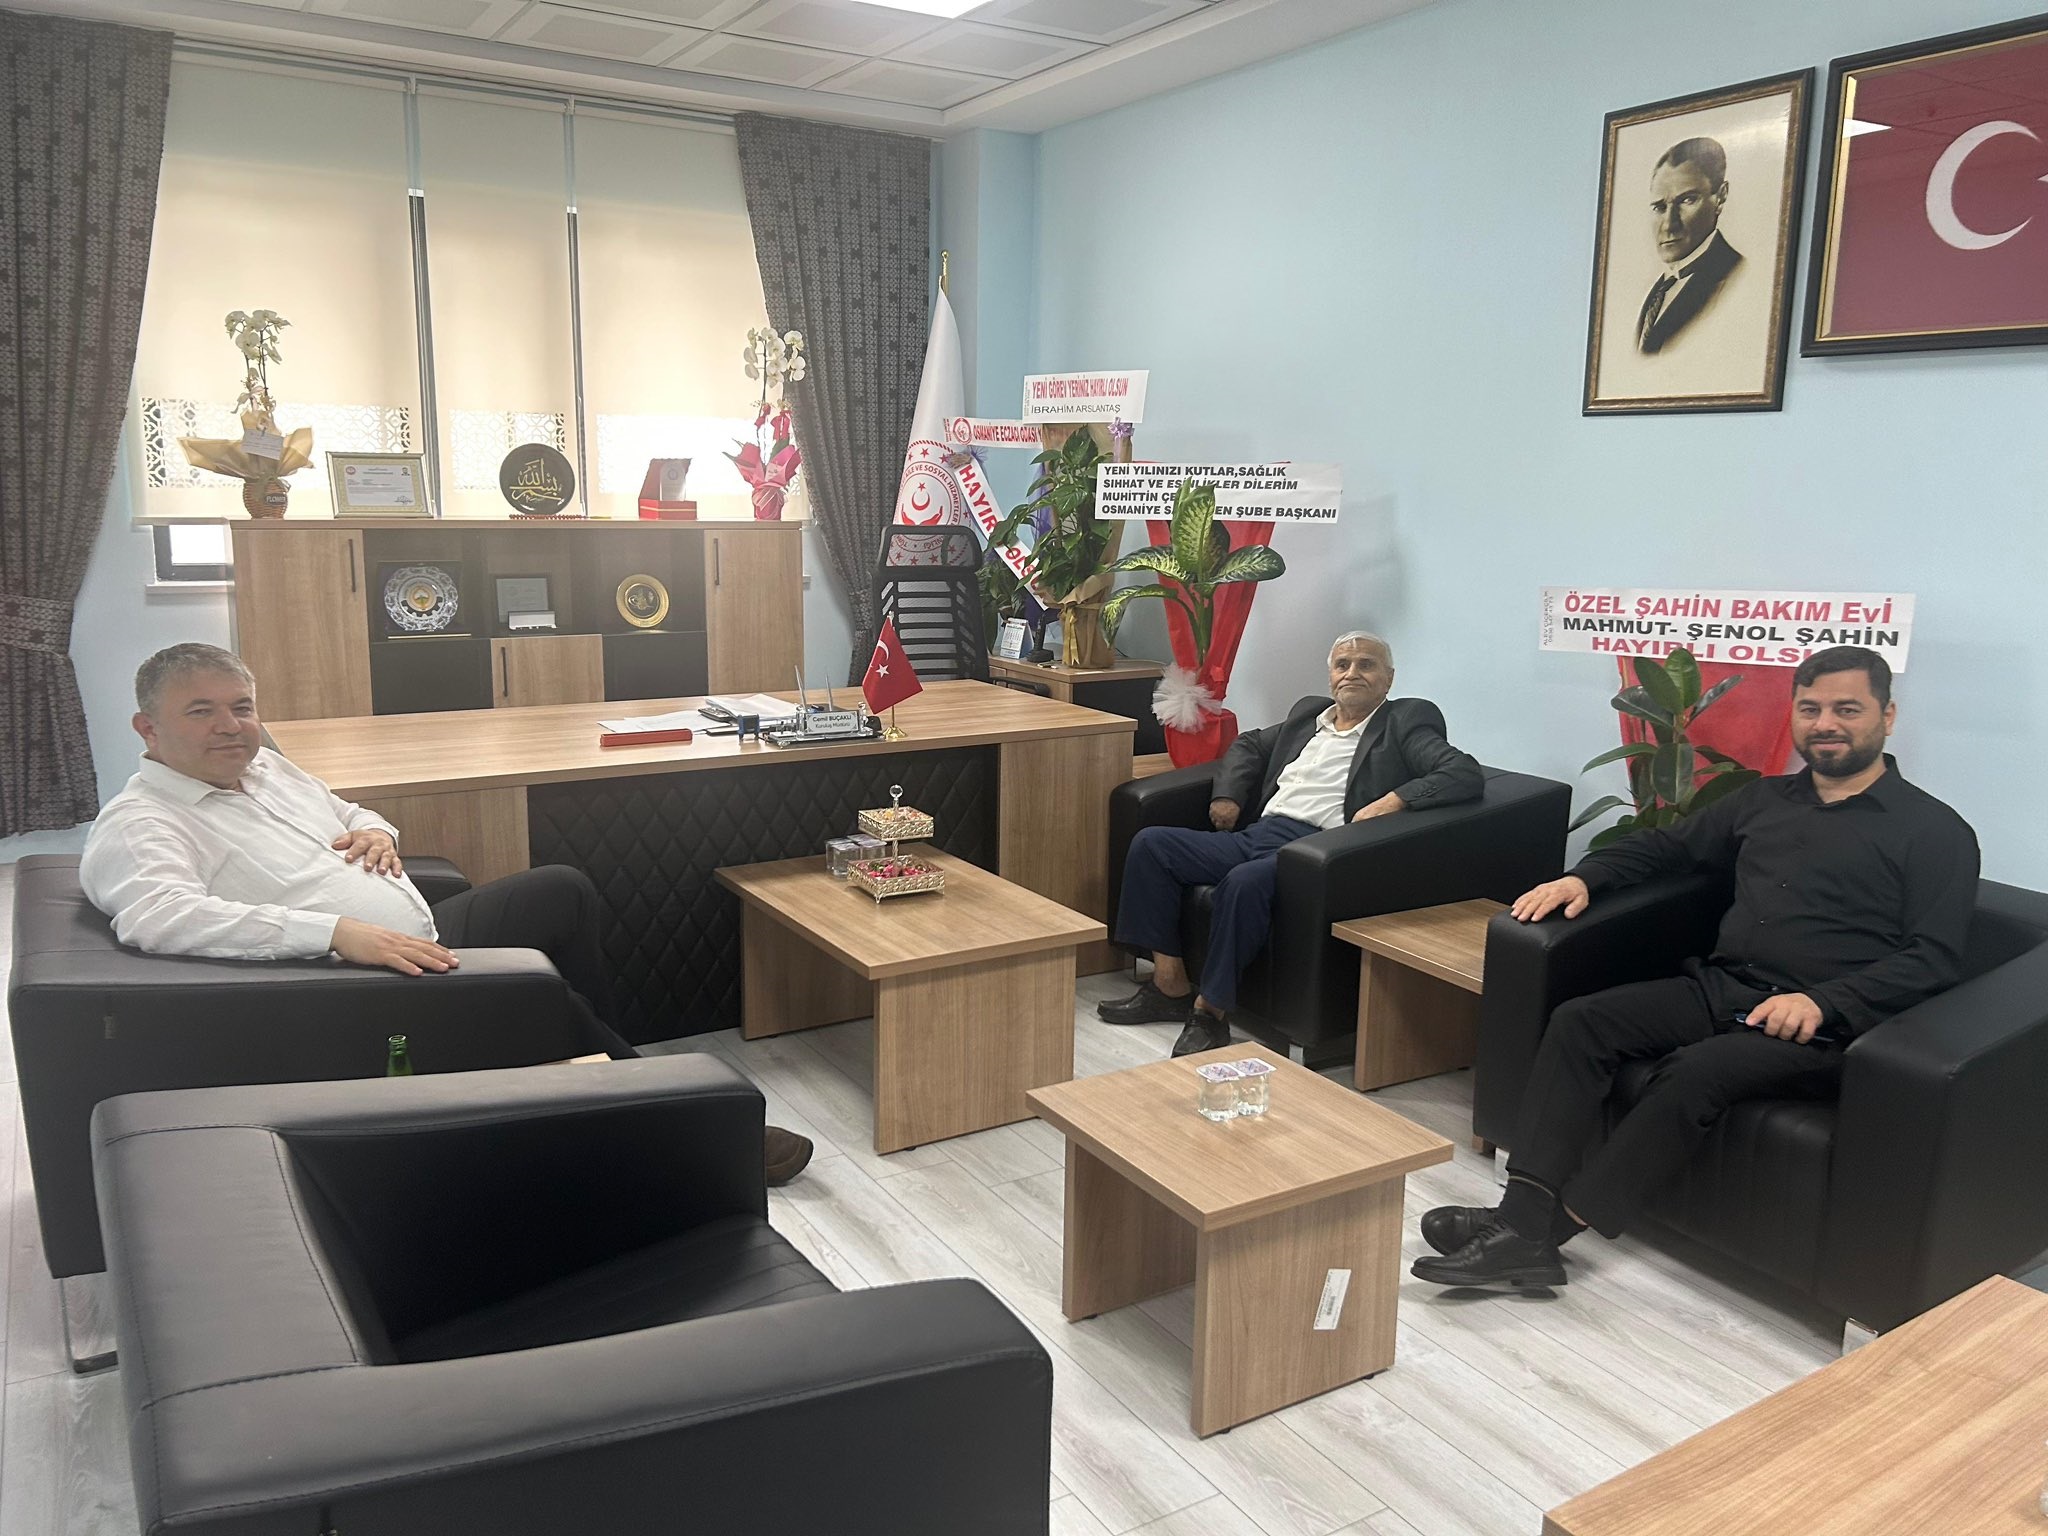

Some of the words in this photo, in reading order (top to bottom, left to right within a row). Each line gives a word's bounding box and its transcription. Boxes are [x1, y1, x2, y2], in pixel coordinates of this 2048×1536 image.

[1032, 377, 1048, 399] YENİ
[1049, 376, 1067, 398] GÖREV
[1068, 375, 1089, 397] YERİNİZ
[1108, 378, 1128, 396] OLSUN
[1031, 405, 1074, 413] İBRAHİM
[1075, 404, 1121, 413] ARSLANTAŞ
[973, 422, 1000, 440] OSMANİYE
[1000, 425, 1020, 442] ECZACI
[1104, 464, 1130, 475] YENİ
[1133, 466, 1181, 475] YILINIZI
[924, 465, 948, 484] SOSYAL
[947, 481, 959, 523] HİZMETLER
[1103, 479, 1145, 488] SIHHAT
[1148, 480, 1166, 488] VE
[1243, 478, 1298, 490] DİLERİM
[959, 464, 1001, 537] HAYIR
[1102, 490, 1158, 501] MUHİTTİN
[1101, 503, 1161, 514] OSMANİYE
[1236, 506, 1272, 518] ŞUBE
[1275, 507, 1337, 520] BAŞKANI
[1564, 591, 1626, 614] ÖZEL
[1634, 594, 1721, 620] ŞAHİN
[1730, 599, 1831, 622] BAKIM
[1563, 617, 1678, 635] MAHMUT-
[1686, 623, 1785, 641] ŞENOL
[1795, 626, 1899, 647] ŞAHİN
[1592, 637, 1715, 658] HAYIRLI
[1728, 645, 1813, 663] OLS
